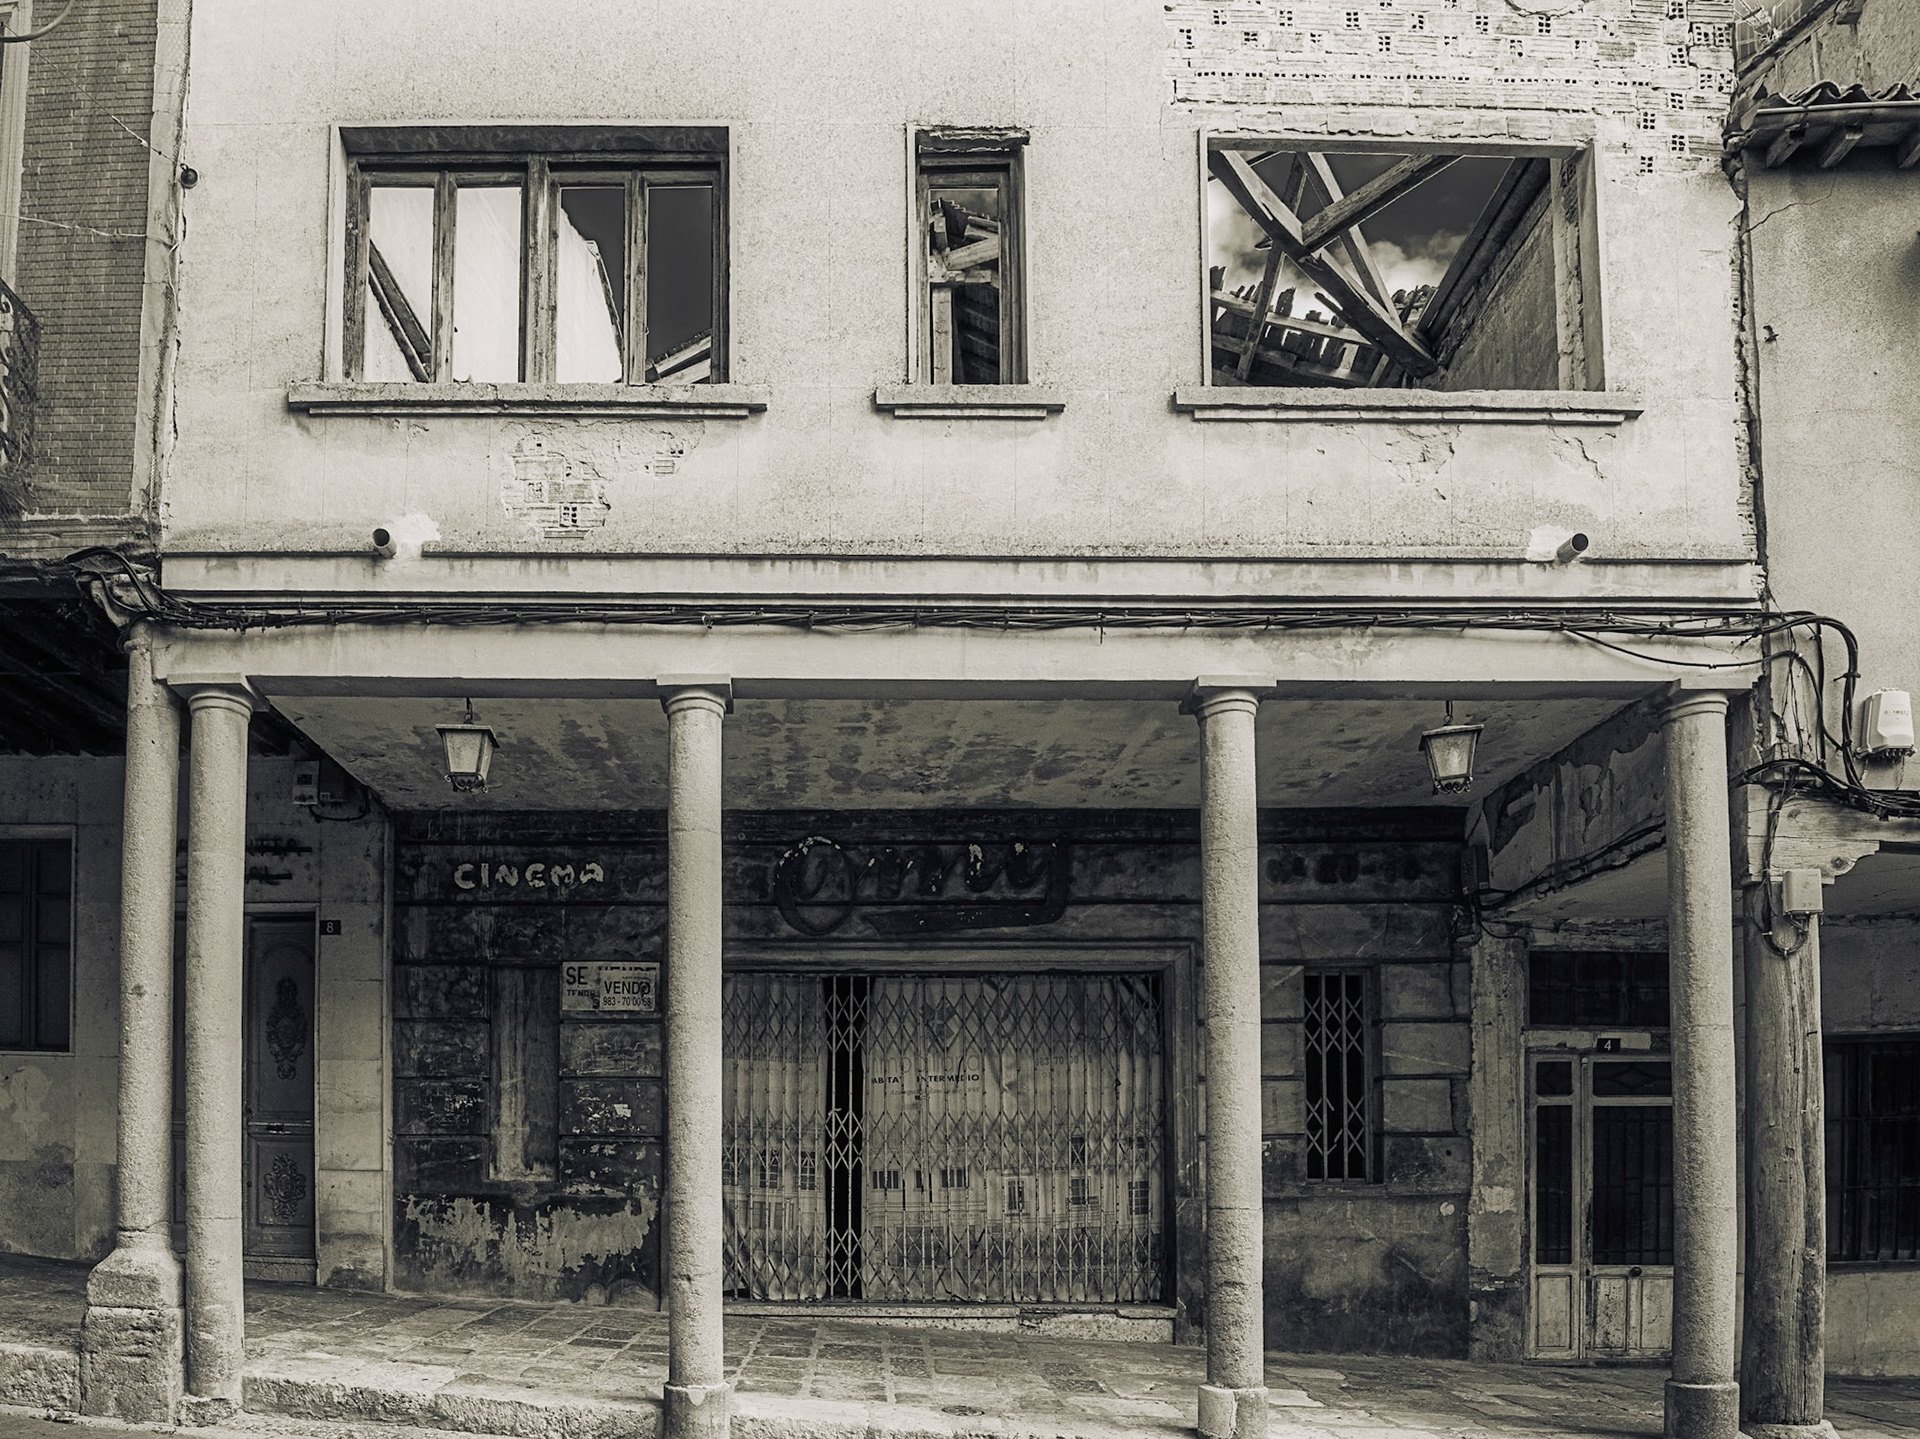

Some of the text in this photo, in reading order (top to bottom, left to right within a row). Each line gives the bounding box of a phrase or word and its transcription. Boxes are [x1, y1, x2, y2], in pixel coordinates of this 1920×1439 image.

[454, 862, 604, 889] CINEMA
[566, 966, 588, 985] SE
[604, 981, 651, 995] VENDO
[603, 996, 616, 1006] 983
[622, 996, 631, 1006] 70
[632, 996, 641, 1006] 00
[1603, 1039, 1612, 1051] 4
[1053, 1055, 1064, 1065] 70
